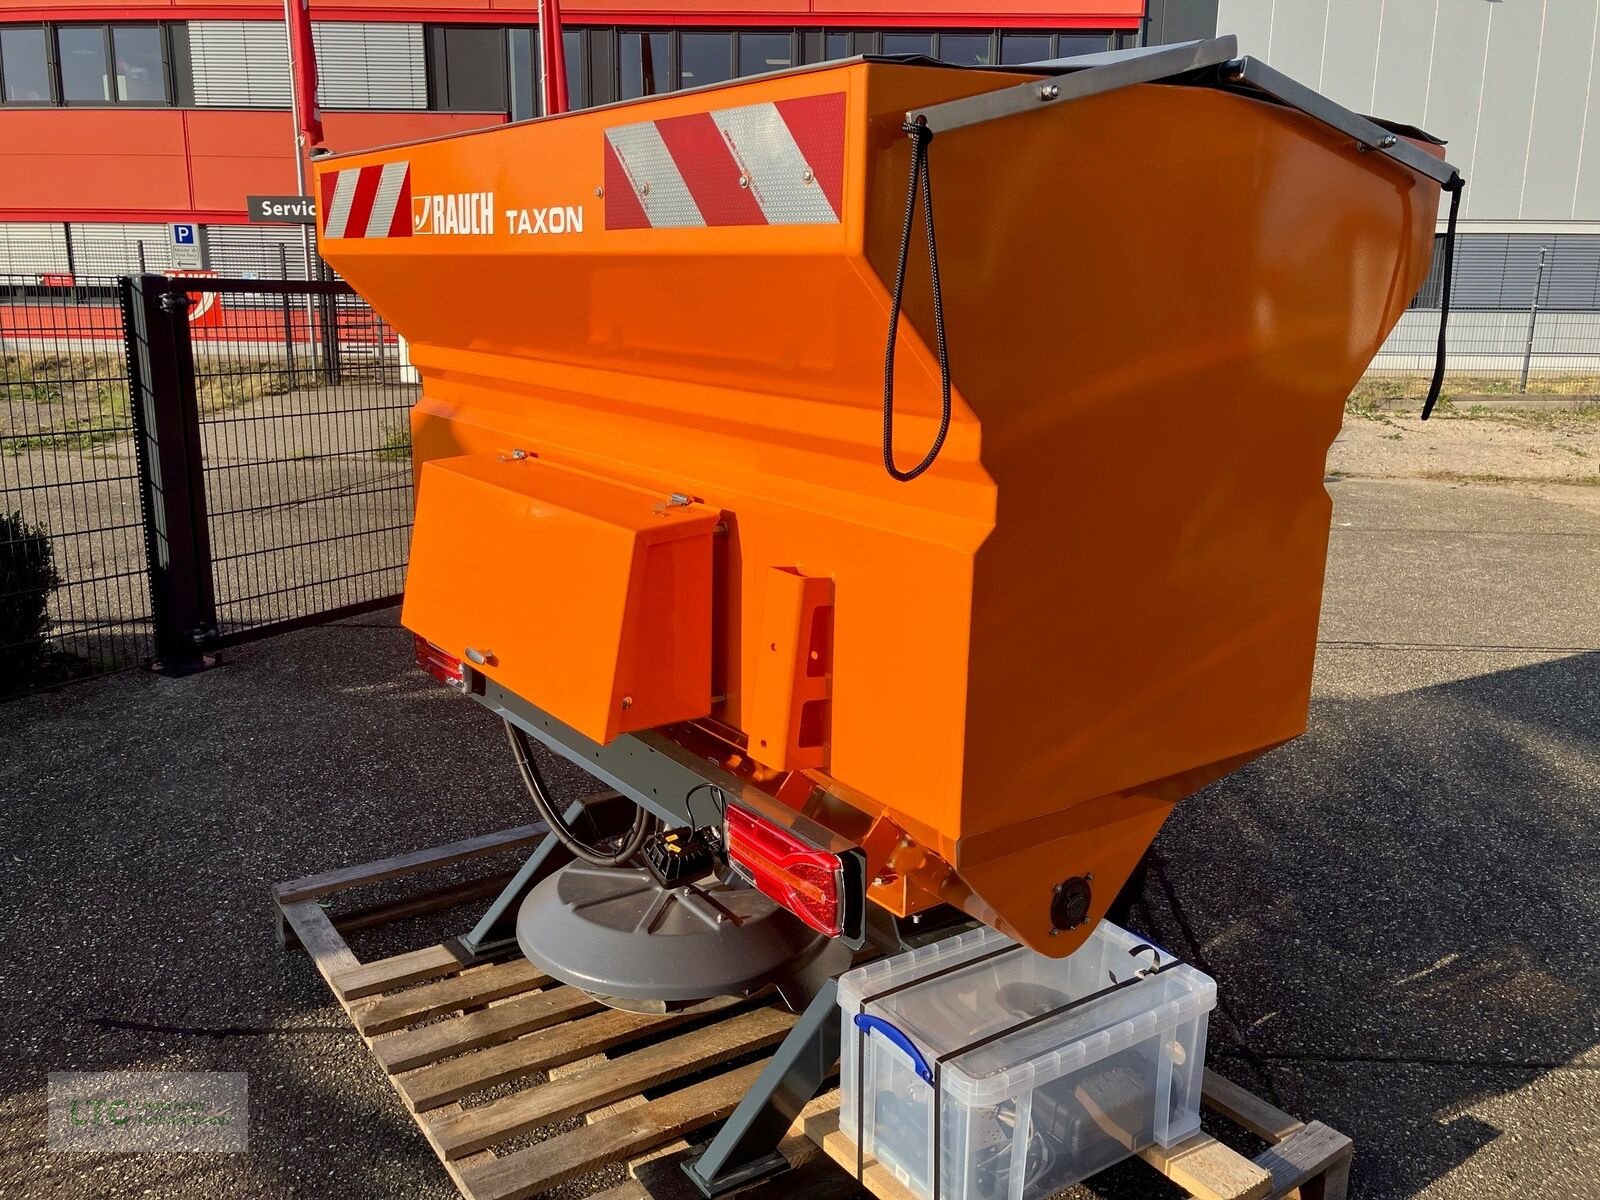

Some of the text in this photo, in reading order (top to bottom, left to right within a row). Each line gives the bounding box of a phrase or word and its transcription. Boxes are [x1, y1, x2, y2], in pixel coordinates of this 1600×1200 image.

[433, 192, 583, 235] RAUCH TAXON
[178, 226, 189, 242] P
